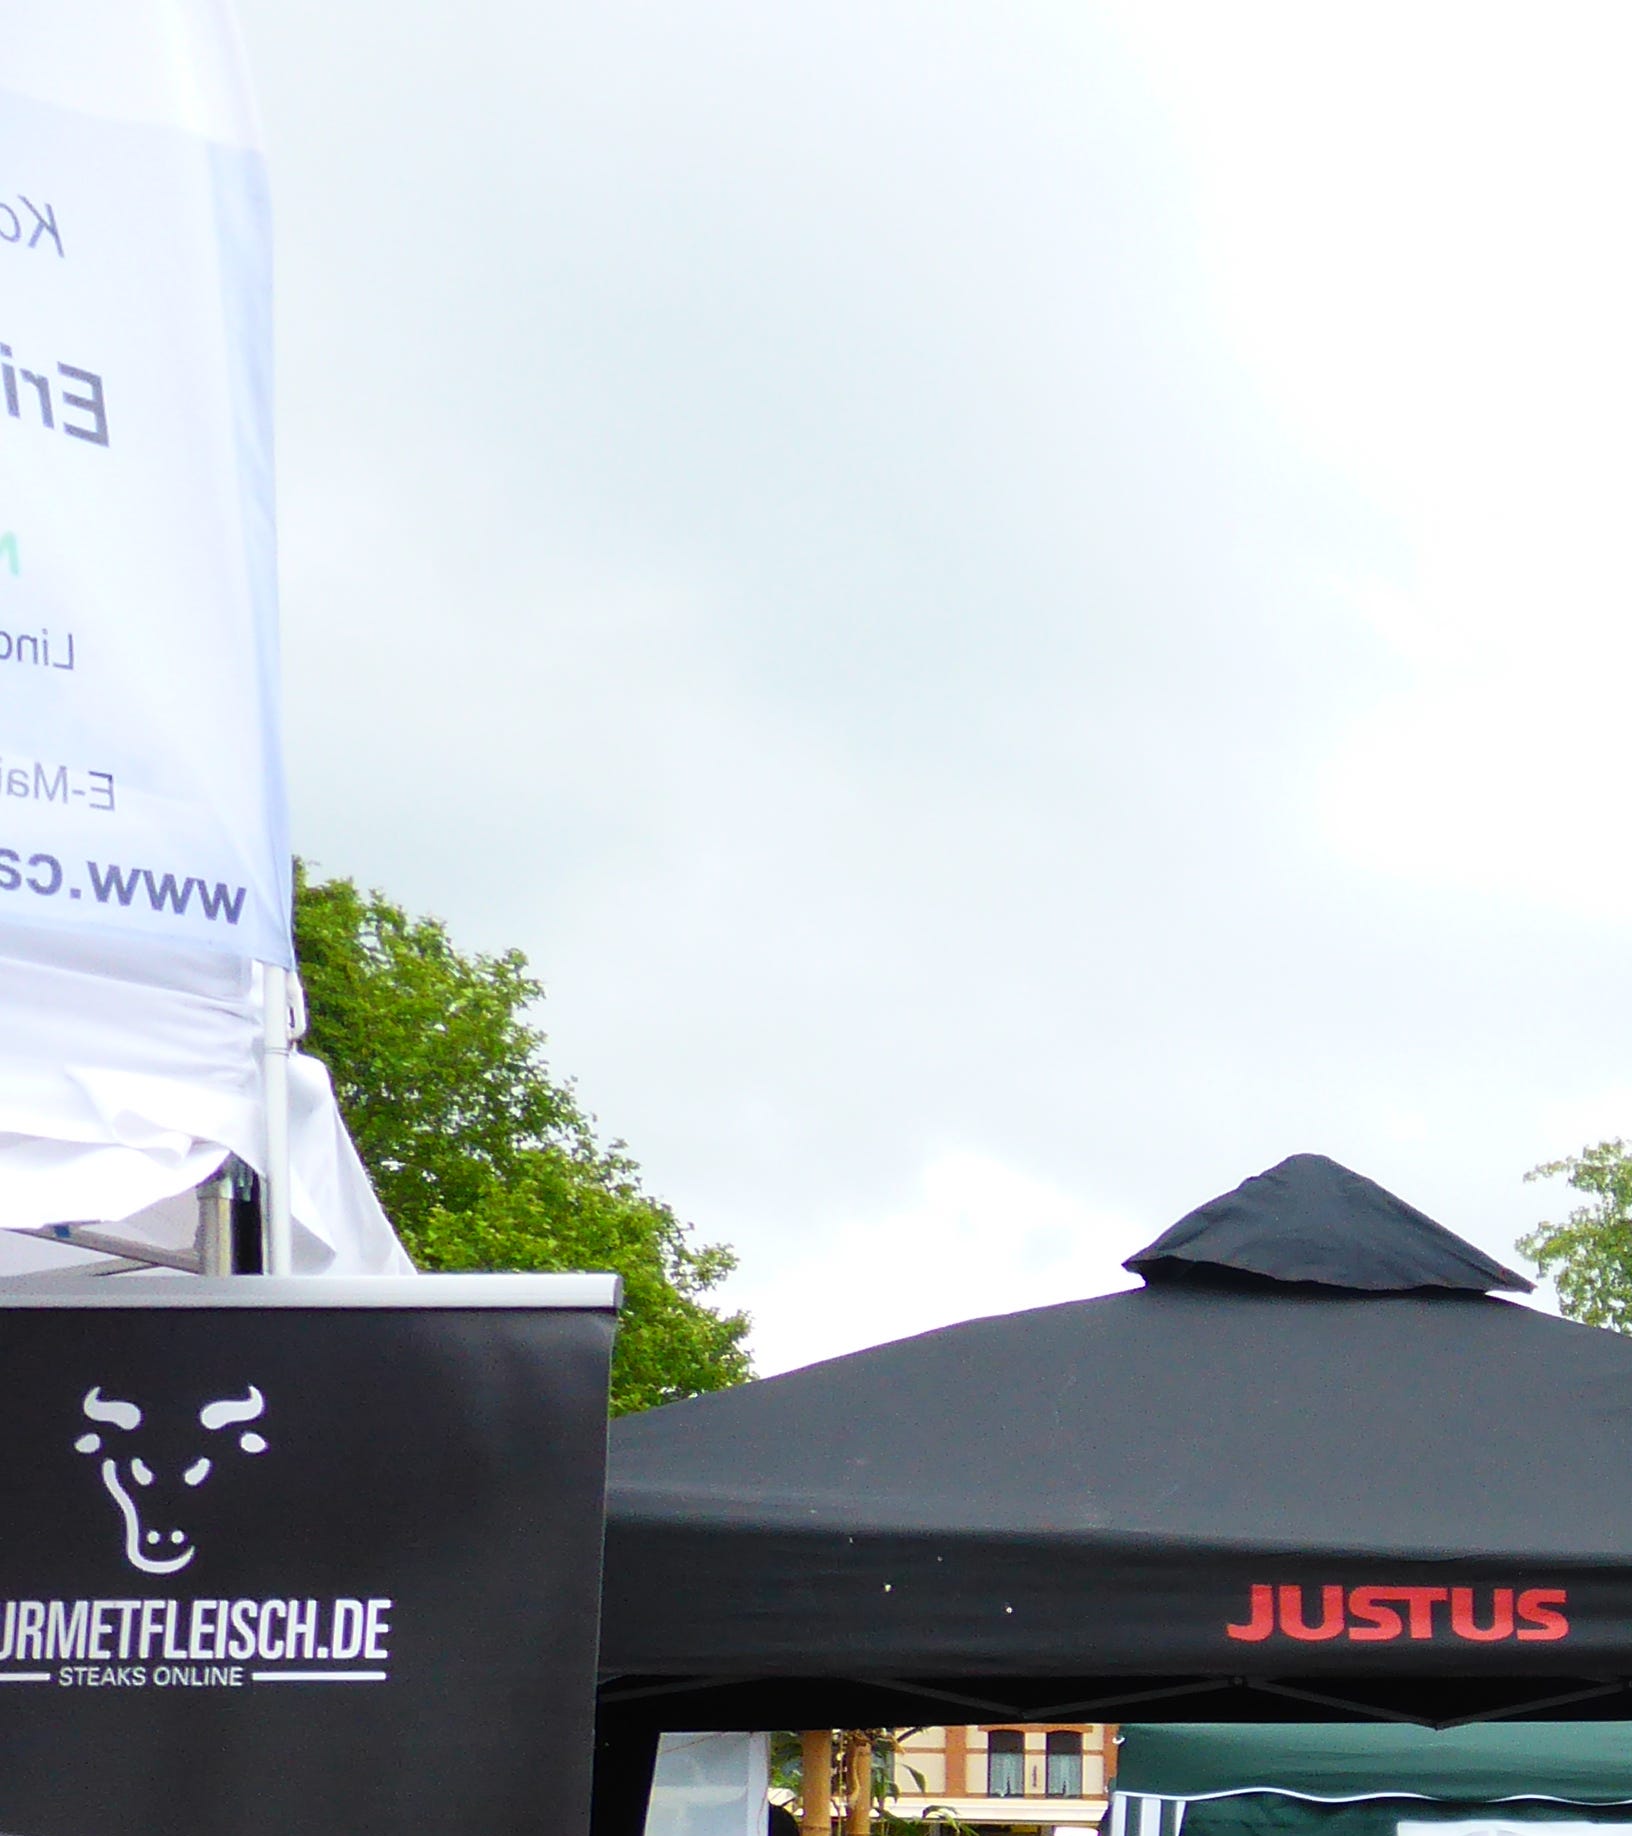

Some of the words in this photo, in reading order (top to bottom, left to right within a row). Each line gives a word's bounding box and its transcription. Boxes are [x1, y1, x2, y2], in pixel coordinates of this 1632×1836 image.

[1226, 1583, 1570, 1643] JUSTUS
[59, 1667, 146, 1687] STEAKS
[153, 1666, 243, 1686] ONLINE
